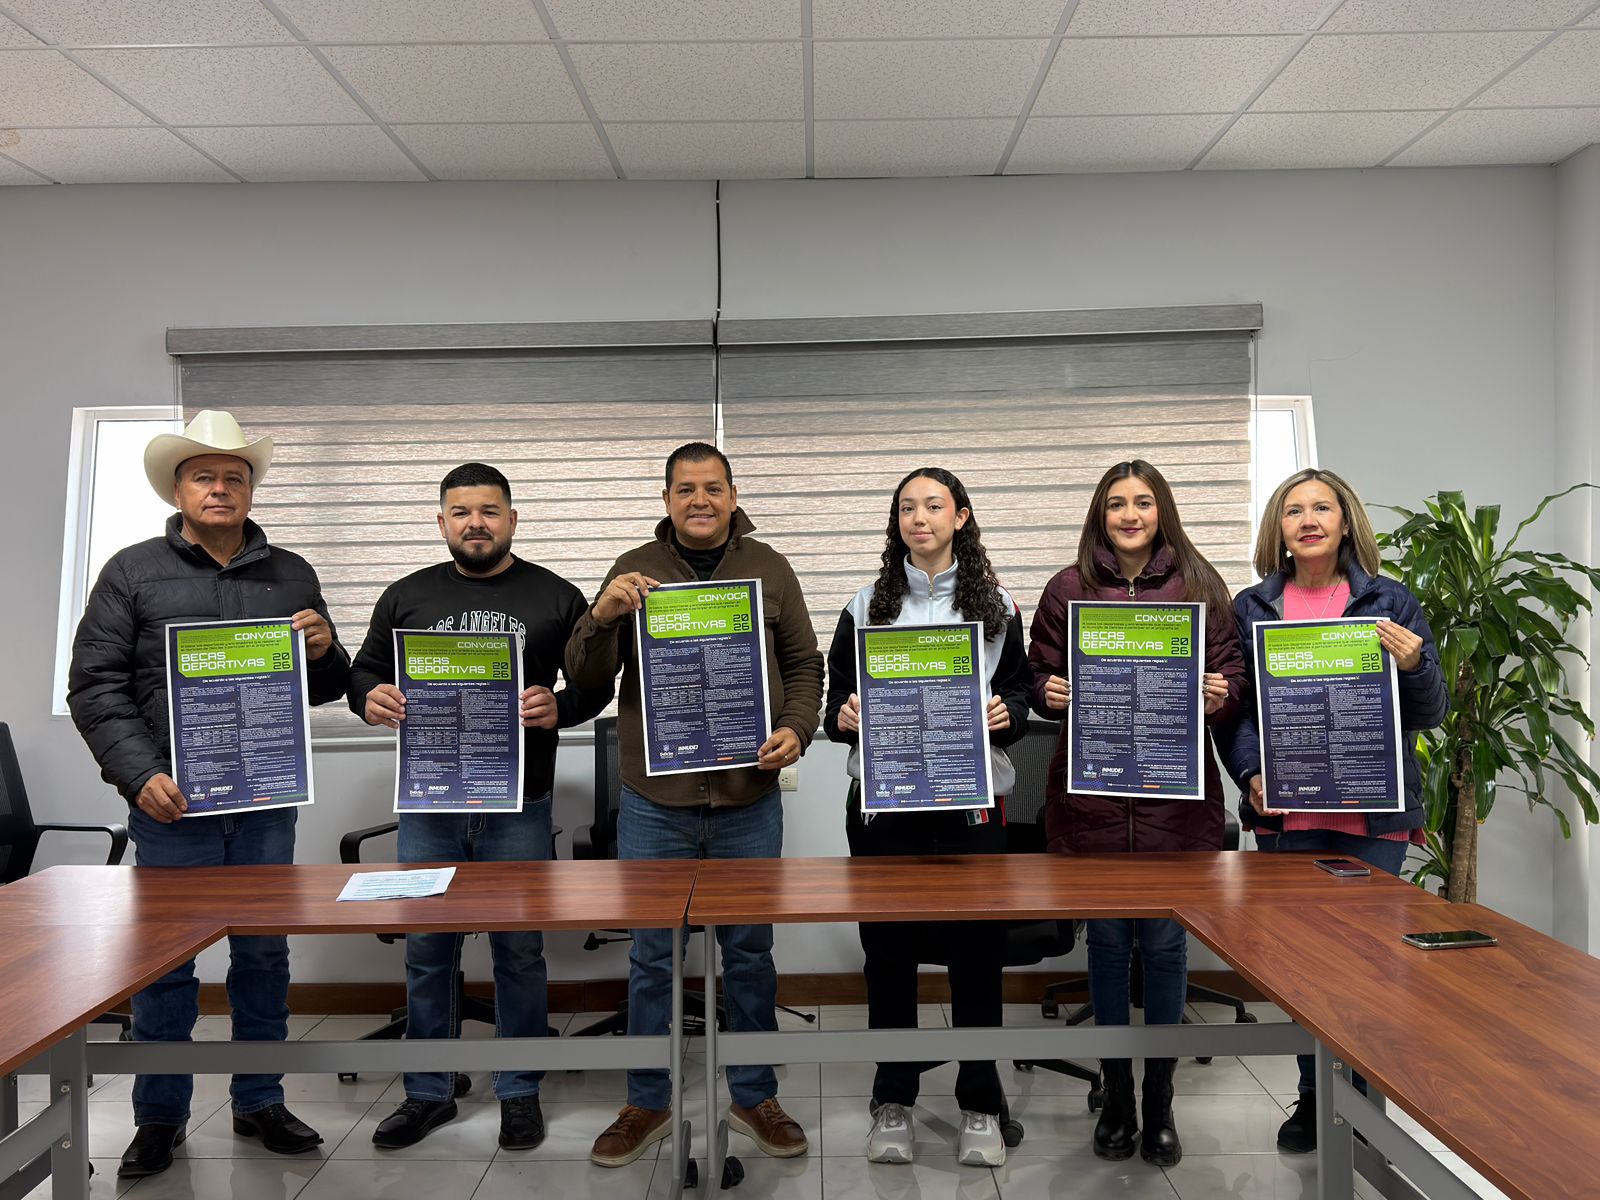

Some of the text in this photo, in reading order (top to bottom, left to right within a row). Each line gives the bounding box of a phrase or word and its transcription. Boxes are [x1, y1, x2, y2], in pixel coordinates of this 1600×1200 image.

[698, 592, 748, 602] CONVOCA
[650, 613, 690, 624] BECAS
[733, 614, 749, 622] 20
[427, 615, 453, 631] OS
[650, 619, 727, 633] DEPORTIVAS
[734, 622, 750, 631] 26
[234, 631, 289, 641] CONVOCA
[918, 635, 969, 644] CONVOCA
[1082, 631, 1125, 640] BECAS
[1322, 630, 1377, 640] CONVOCA
[1082, 640, 1163, 650] DEPORTIVAS
[1171, 637, 1188, 646] 20
[1171, 646, 1188, 655] 26
[181, 652, 226, 662] BECAS
[273, 652, 290, 661] 20
[409, 657, 450, 665] BECAS
[869, 654, 910, 664] BECAS
[953, 656, 970, 664] 20
[1269, 651, 1314, 662] BECAS
[1361, 653, 1380, 662] 20
[181, 658, 266, 672] DEPORTIVAS
[273, 661, 290, 670] 26
[869, 661, 947, 673] DEPORTIVAS
[954, 665, 970, 673] 26
[1270, 658, 1354, 671] DEPORTIVAS
[1362, 662, 1380, 671] 26
[409, 666, 486, 674] DEPORTIVAS
[493, 670, 508, 678] 26
